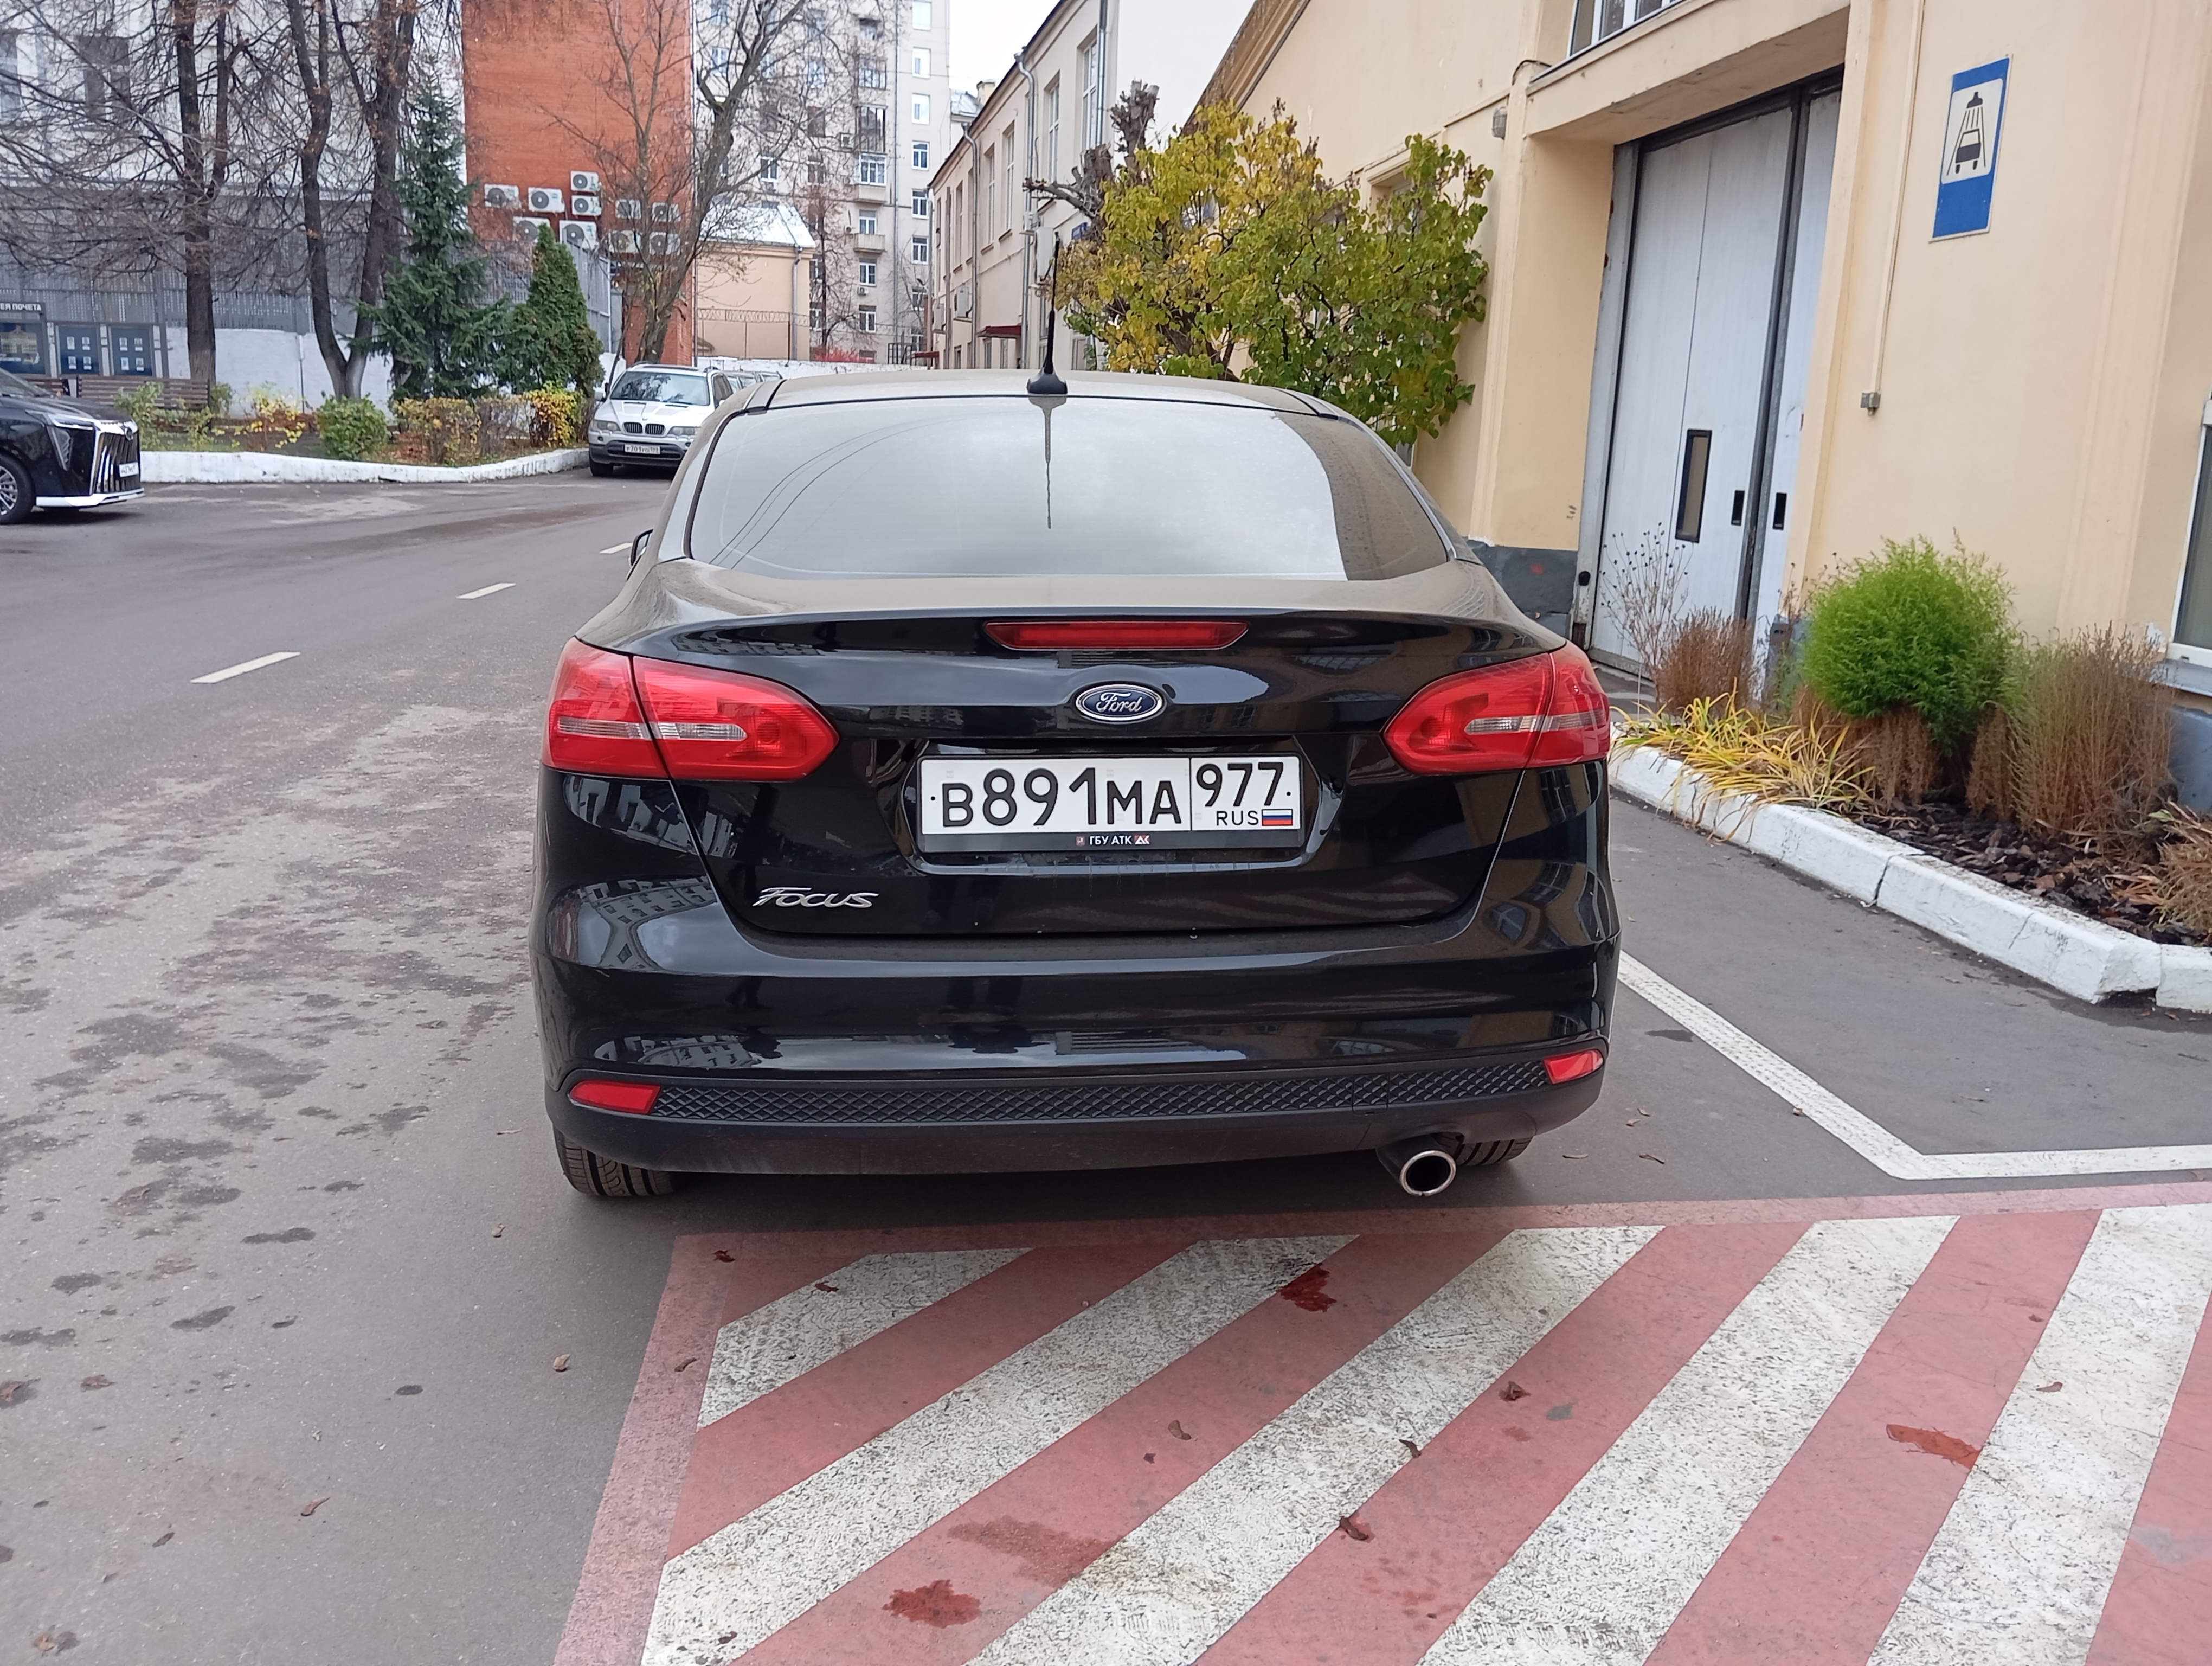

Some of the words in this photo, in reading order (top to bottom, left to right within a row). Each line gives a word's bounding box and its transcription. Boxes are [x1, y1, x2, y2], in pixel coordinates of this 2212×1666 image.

[12, 303, 42, 311] ПОЧЕТА
[1096, 691, 1143, 713] Ford
[942, 767, 1182, 828] В891МА
[1195, 761, 1284, 808] 977
[1216, 810, 1259, 826] RUS
[1089, 835, 1109, 845] ГБУ
[1111, 835, 1133, 845] АТК
